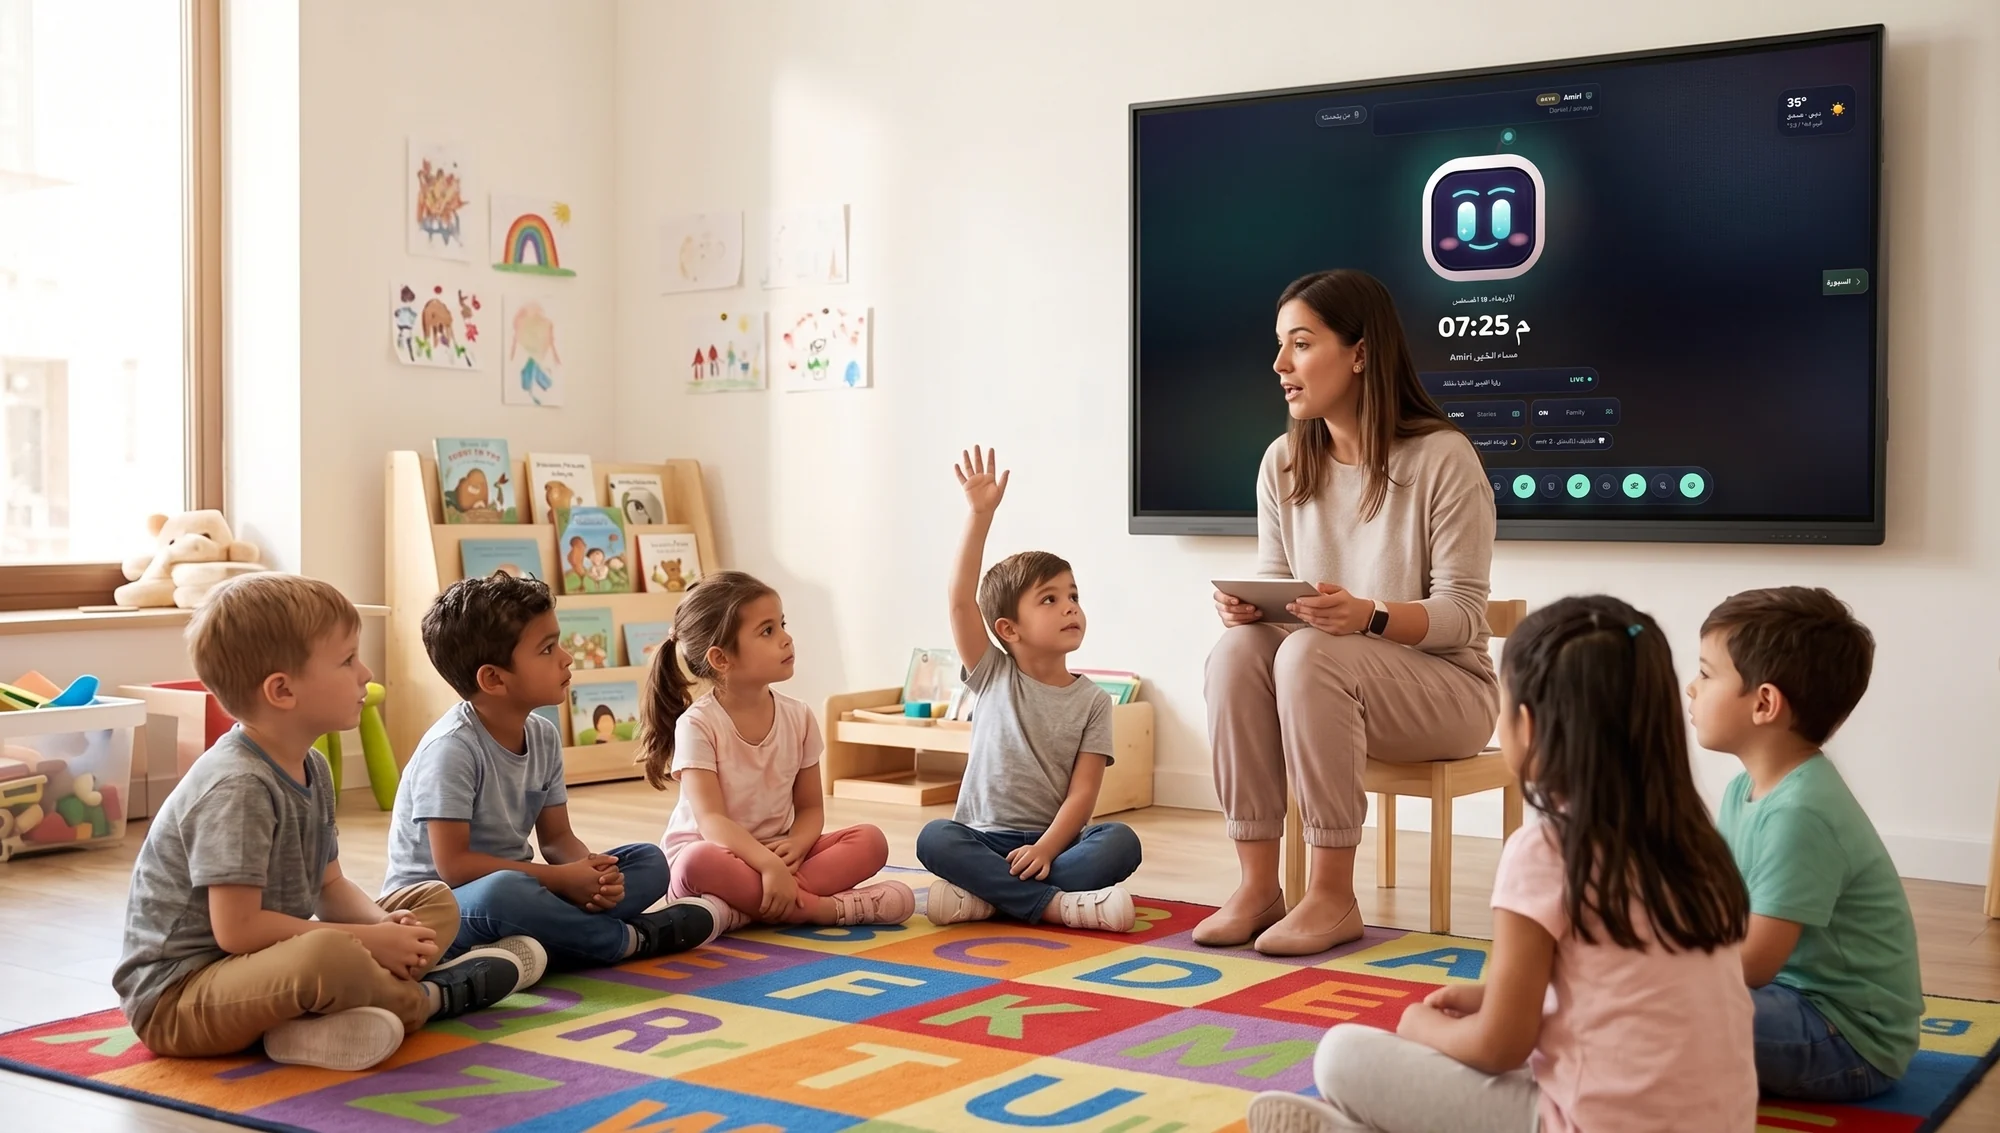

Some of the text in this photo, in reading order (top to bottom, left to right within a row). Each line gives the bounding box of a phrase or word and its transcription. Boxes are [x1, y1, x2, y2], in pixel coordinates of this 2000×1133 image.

[1786, 96, 1807, 108] 35°
[1826, 278, 1852, 288] السبورة
[1438, 314, 1531, 346] 07:25 م
[1449, 353, 1473, 362] Amiri
[932, 936, 1073, 968] C
[1363, 946, 1487, 981] A
[763, 969, 928, 1001] F
[1072, 956, 1223, 990] D
[918, 993, 1102, 1041] K
[1259, 980, 1412, 1021] E
[555, 1006, 724, 1054] R
[796, 1042, 963, 1091] T
[1118, 1023, 1320, 1080] M
[964, 1073, 1148, 1128] U
